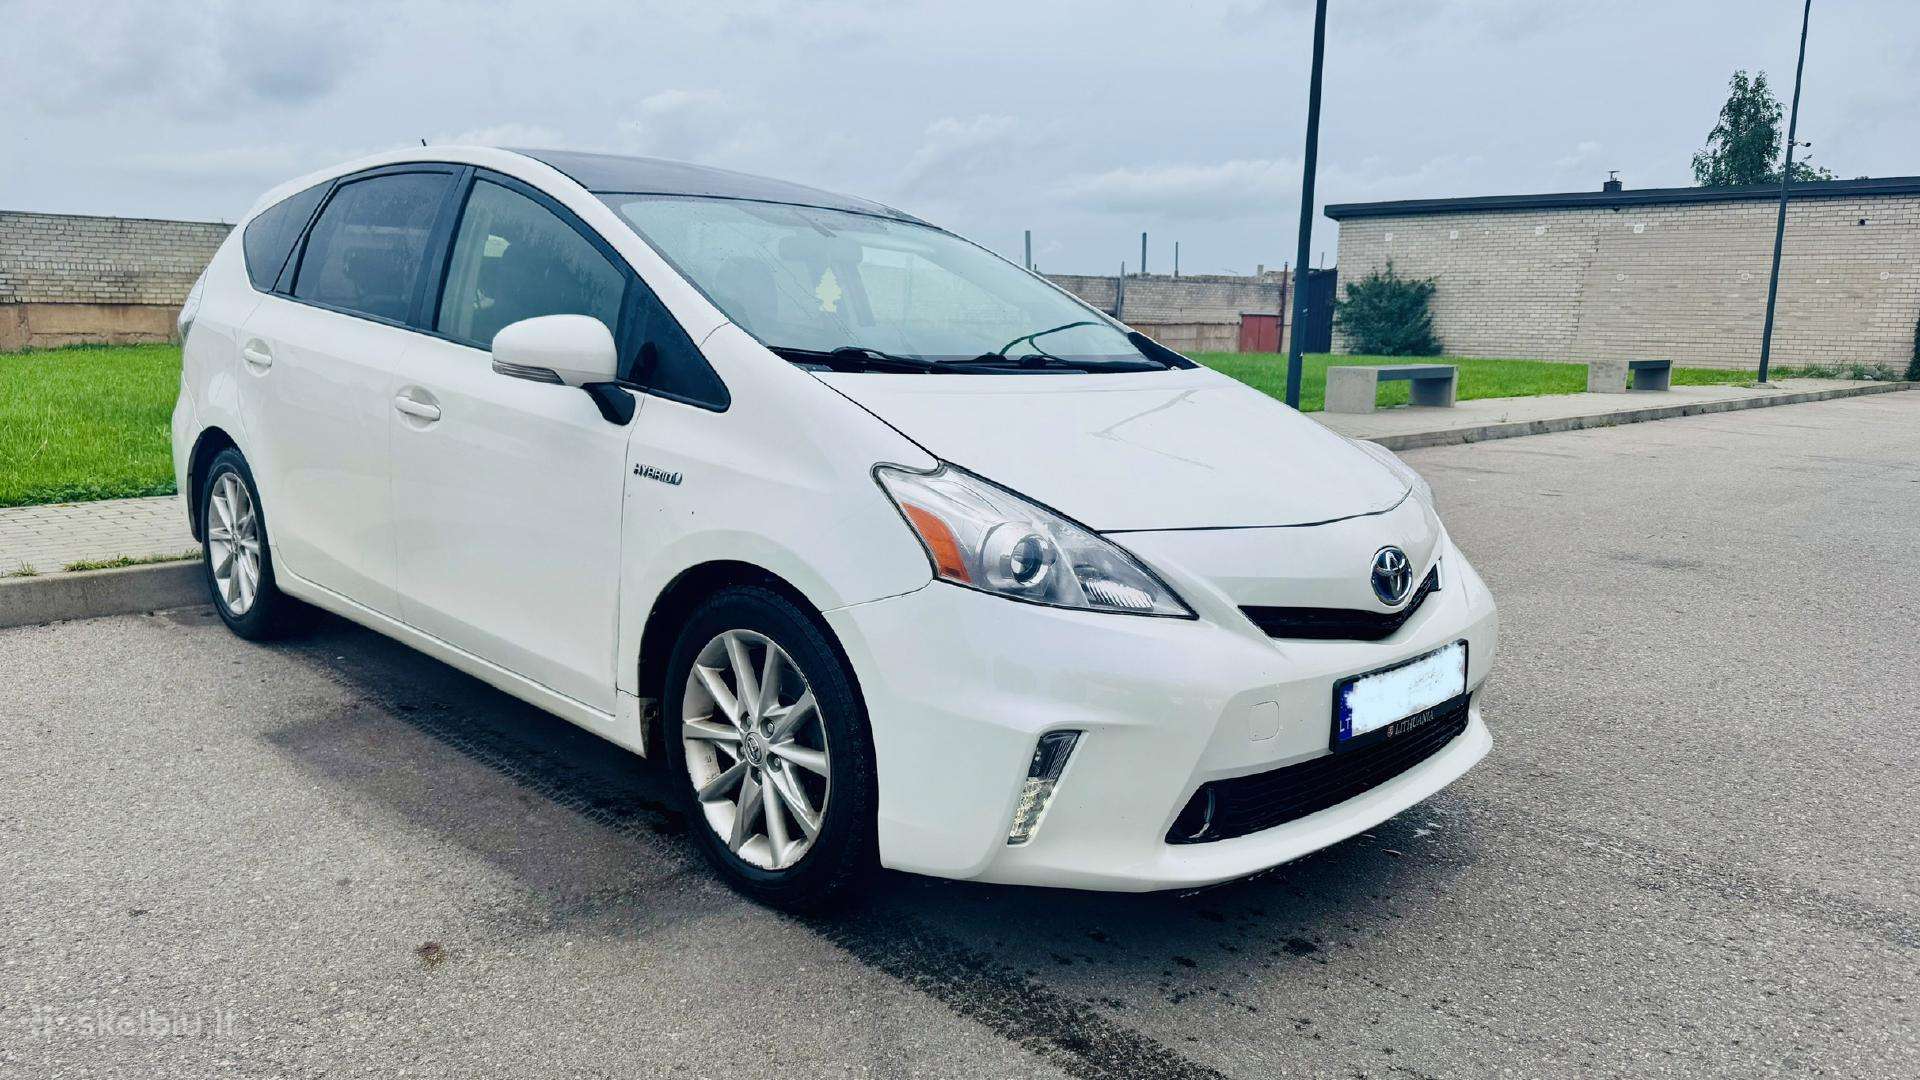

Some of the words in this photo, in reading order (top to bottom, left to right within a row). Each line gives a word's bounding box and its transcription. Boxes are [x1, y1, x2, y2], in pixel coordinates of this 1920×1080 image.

[633, 463, 676, 484] HYBRID
[1339, 717, 1352, 733] LT
[1395, 709, 1434, 735] LITHUANIA
